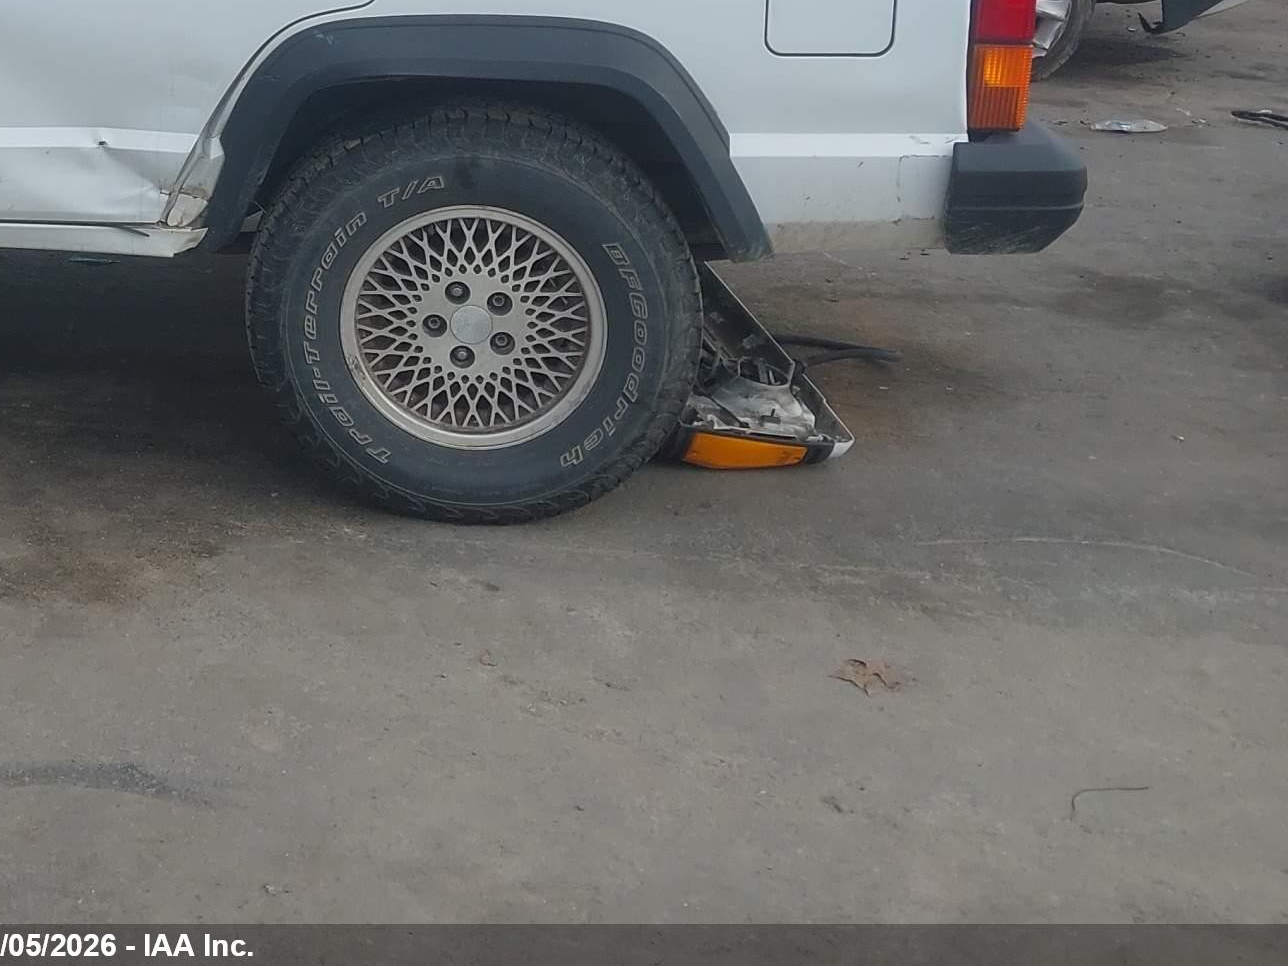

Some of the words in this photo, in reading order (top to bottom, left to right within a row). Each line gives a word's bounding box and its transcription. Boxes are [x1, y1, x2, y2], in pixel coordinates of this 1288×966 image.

[303, 212, 392, 464] Trail-Terrain
[377, 175, 445, 209] T/A
[559, 242, 649, 468] BFGoodrich
